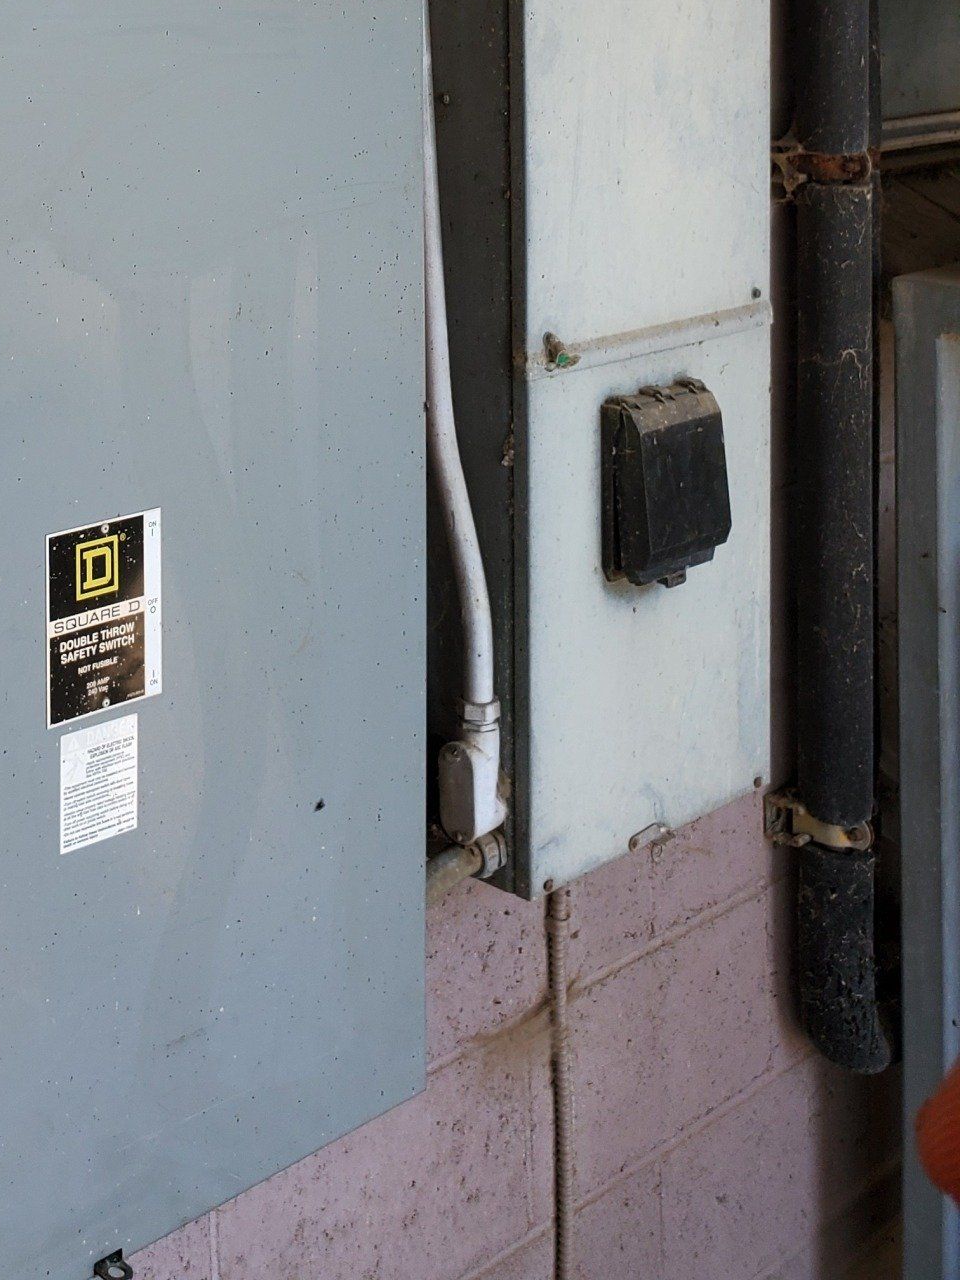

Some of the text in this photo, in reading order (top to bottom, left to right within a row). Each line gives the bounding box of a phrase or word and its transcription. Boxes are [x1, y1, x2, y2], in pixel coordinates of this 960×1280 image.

[54, 600, 140, 634] SQUARE D
[60, 621, 135, 653] DOUBLE THROW
[60, 633, 135, 665] SAFETY SWITCH
[77, 656, 119, 674] NOT FUSIBLE
